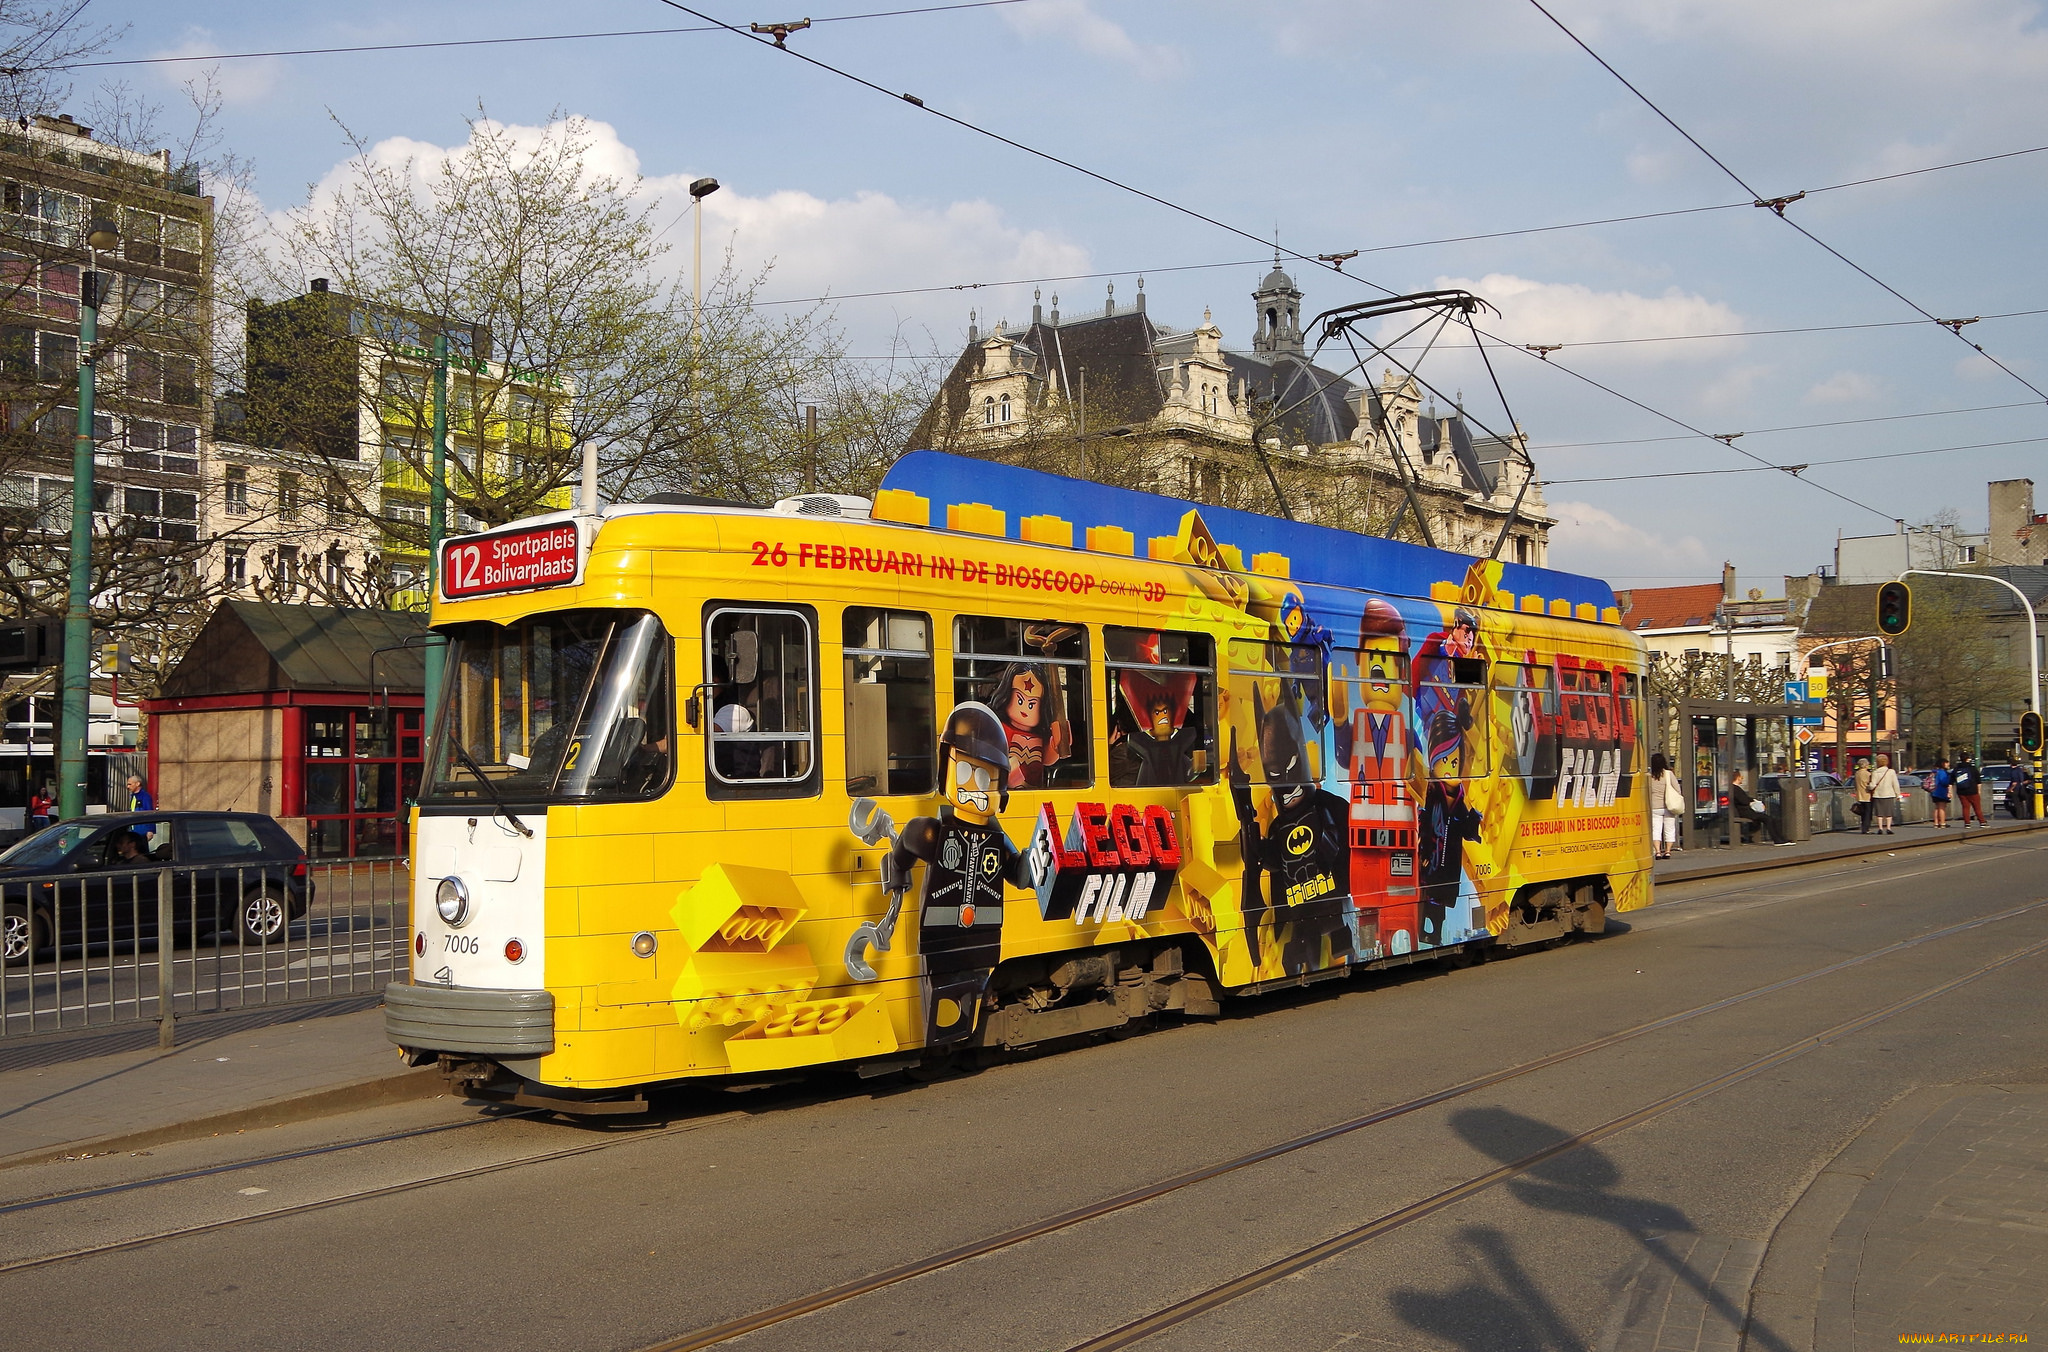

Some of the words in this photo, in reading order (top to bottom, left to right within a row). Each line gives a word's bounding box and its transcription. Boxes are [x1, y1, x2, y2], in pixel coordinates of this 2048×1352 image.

[492, 529, 575, 562] Sportpaleis
[450, 545, 480, 589] 12
[484, 555, 574, 583] Bolivarplaats
[751, 541, 788, 567] 26
[799, 543, 923, 577] FEBRUARI
[931, 556, 955, 580] IN
[962, 560, 989, 584] DE
[995, 563, 1095, 595] BIOSCOOP
[1100, 580, 1126, 596] OOK
[1129, 583, 1142, 597] IN
[1144, 582, 1166, 602] 3D
[1524, 648, 1634, 743] LEGO
[565, 742, 581, 770] 2
[1557, 748, 1621, 808] FILM
[1041, 801, 1182, 872] LEGO
[1521, 823, 1530, 837] 26
[1532, 821, 1565, 836] FEBRUARI
[1567, 819, 1575, 832] IN
[1577, 818, 1586, 832] DE
[1587, 816, 1620, 831] BIOSCOOP
[1475, 863, 1492, 876] 7006
[1075, 872, 1156, 925] FILM
[444, 934, 479, 954] 7006
